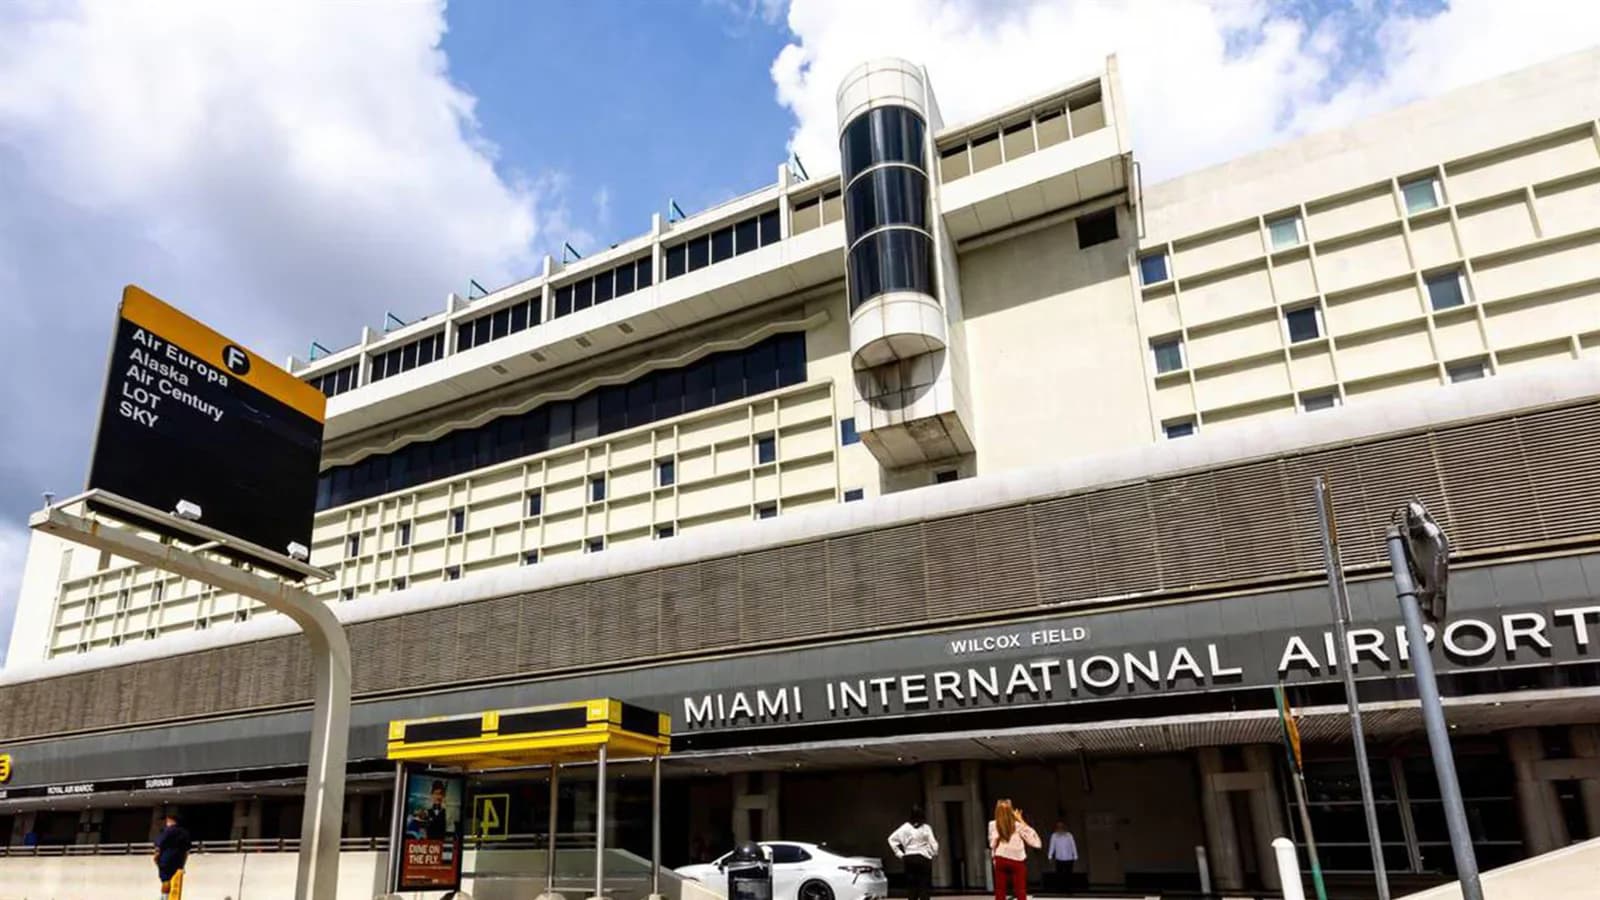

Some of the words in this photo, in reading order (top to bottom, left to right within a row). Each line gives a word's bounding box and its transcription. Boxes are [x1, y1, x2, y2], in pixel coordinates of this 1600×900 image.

[129, 348, 190, 386] Alaska
[132, 329, 161, 351] Air
[165, 342, 228, 388] Europa
[228, 347, 245, 369] F
[122, 382, 161, 409] LOT
[126, 365, 154, 385] Air
[158, 378, 224, 422] Century
[119, 400, 159, 428] SKY
[951, 633, 1021, 653] WILCOX
[1031, 627, 1085, 645] FIELD
[684, 686, 802, 723] MIAMI
[826, 644, 1243, 711] INTERNATIONAL
[409, 844, 427, 854] DINE
[428, 845, 440, 854] ON
[409, 855, 424, 865] THE
